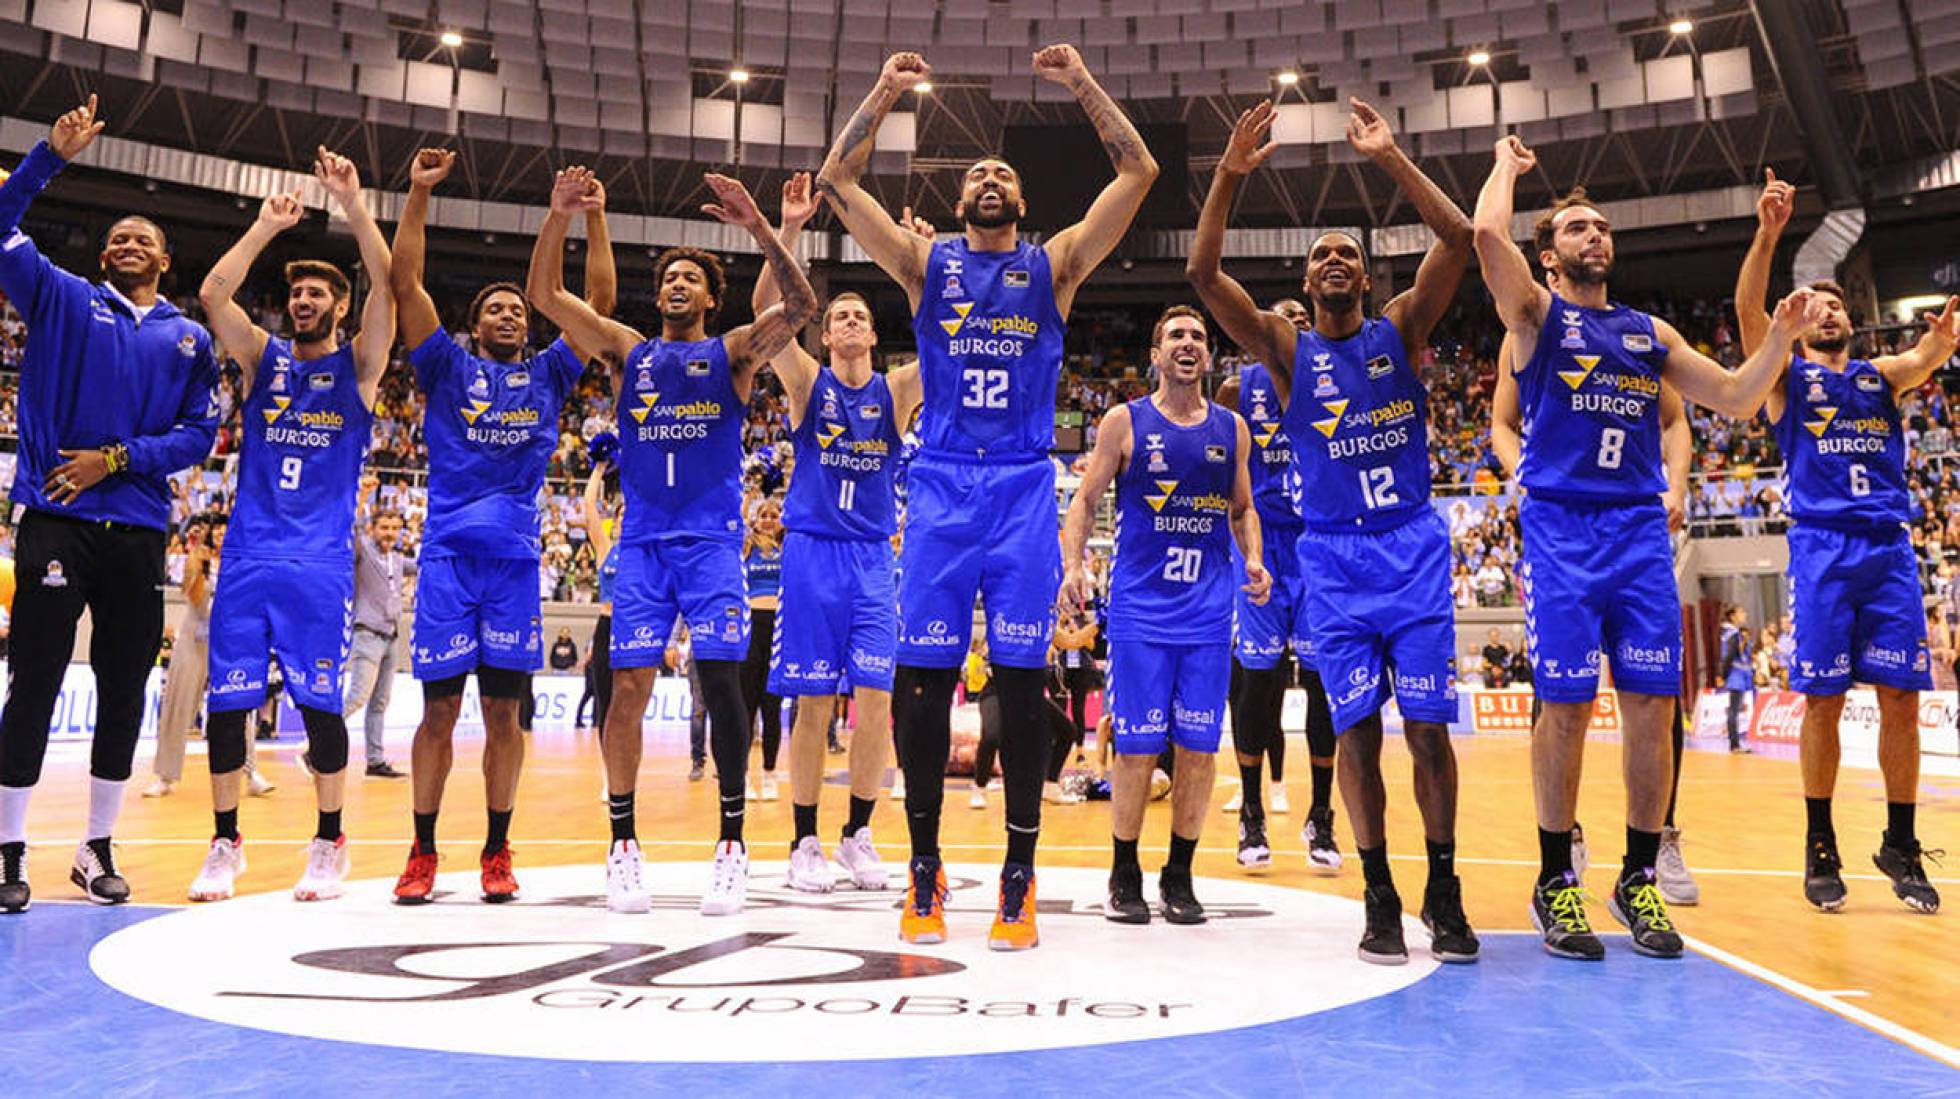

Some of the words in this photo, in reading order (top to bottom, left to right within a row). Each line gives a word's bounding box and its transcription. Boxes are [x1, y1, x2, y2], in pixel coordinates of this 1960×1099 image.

[949, 337, 1024, 357] BURGOS
[963, 369, 1009, 408] 32
[265, 428, 331, 448] BURGOS
[467, 427, 531, 445] BURGOS
[638, 423, 708, 441] BURGOS
[1327, 427, 1409, 459] BURGOS
[820, 452, 881, 471] BURGOS
[1262, 450, 1290, 464] BUR
[1597, 428, 1626, 469] 8
[279, 456, 302, 490] 9
[1359, 466, 1399, 509] 12
[1849, 463, 1871, 496] 6
[838, 479, 855, 511] 11
[1163, 545, 1202, 583] 20
[909, 635, 960, 646] LEXUS
[532, 989, 1193, 1018] GrupoBafer
